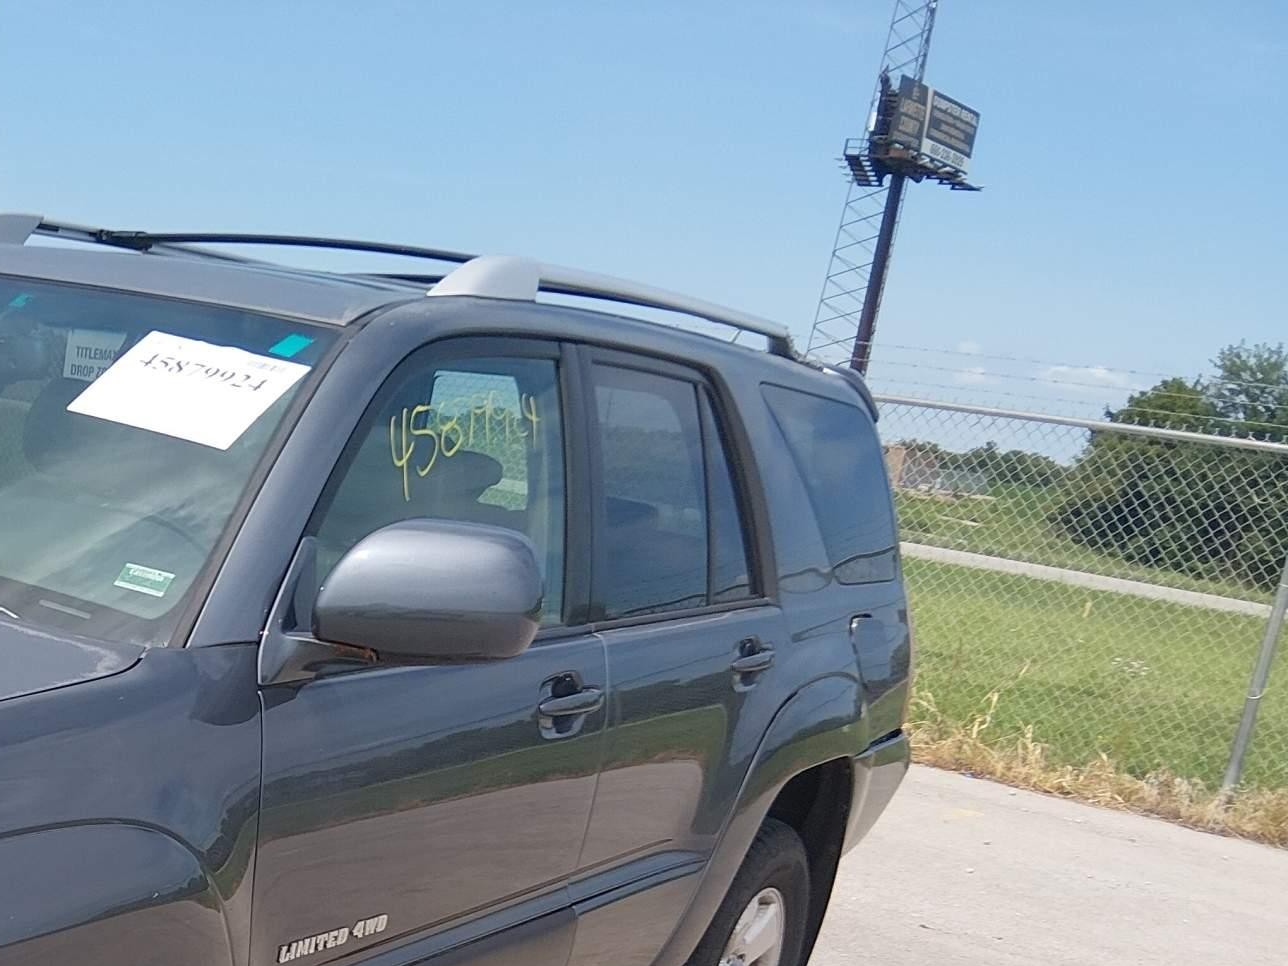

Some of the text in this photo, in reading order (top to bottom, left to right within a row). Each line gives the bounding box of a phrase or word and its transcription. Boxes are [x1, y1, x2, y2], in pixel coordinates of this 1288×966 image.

[70, 363, 95, 378] DROP
[139, 352, 269, 392] 45879924
[277, 913, 389, 964] LIMITED 4WD
